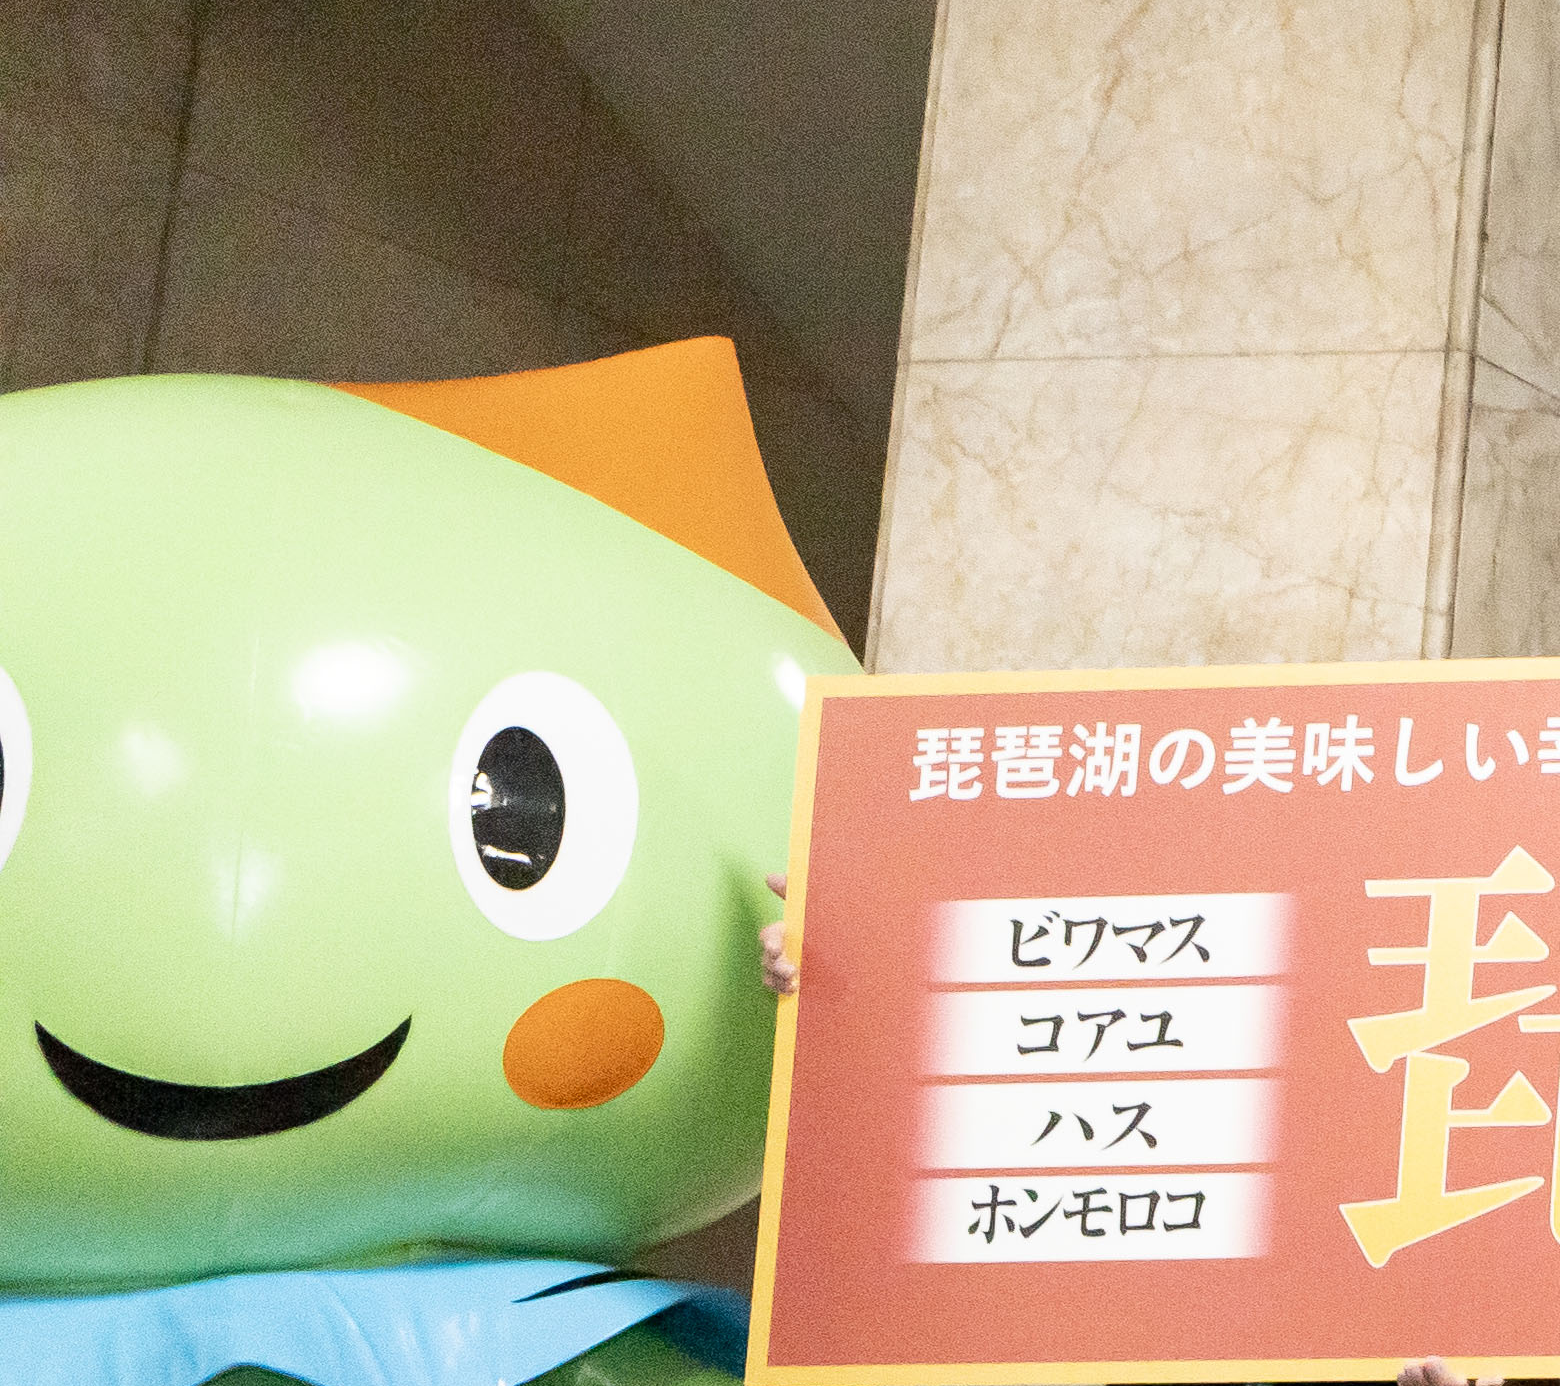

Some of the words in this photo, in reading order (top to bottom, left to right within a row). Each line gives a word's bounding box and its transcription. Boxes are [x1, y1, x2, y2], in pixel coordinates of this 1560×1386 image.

[1008, 911, 1211, 969] ビワマス
[1016, 1008, 1185, 1059] コアユ
[1031, 1099, 1159, 1150] ハス
[967, 1183, 1206, 1244] ホンモロコ
